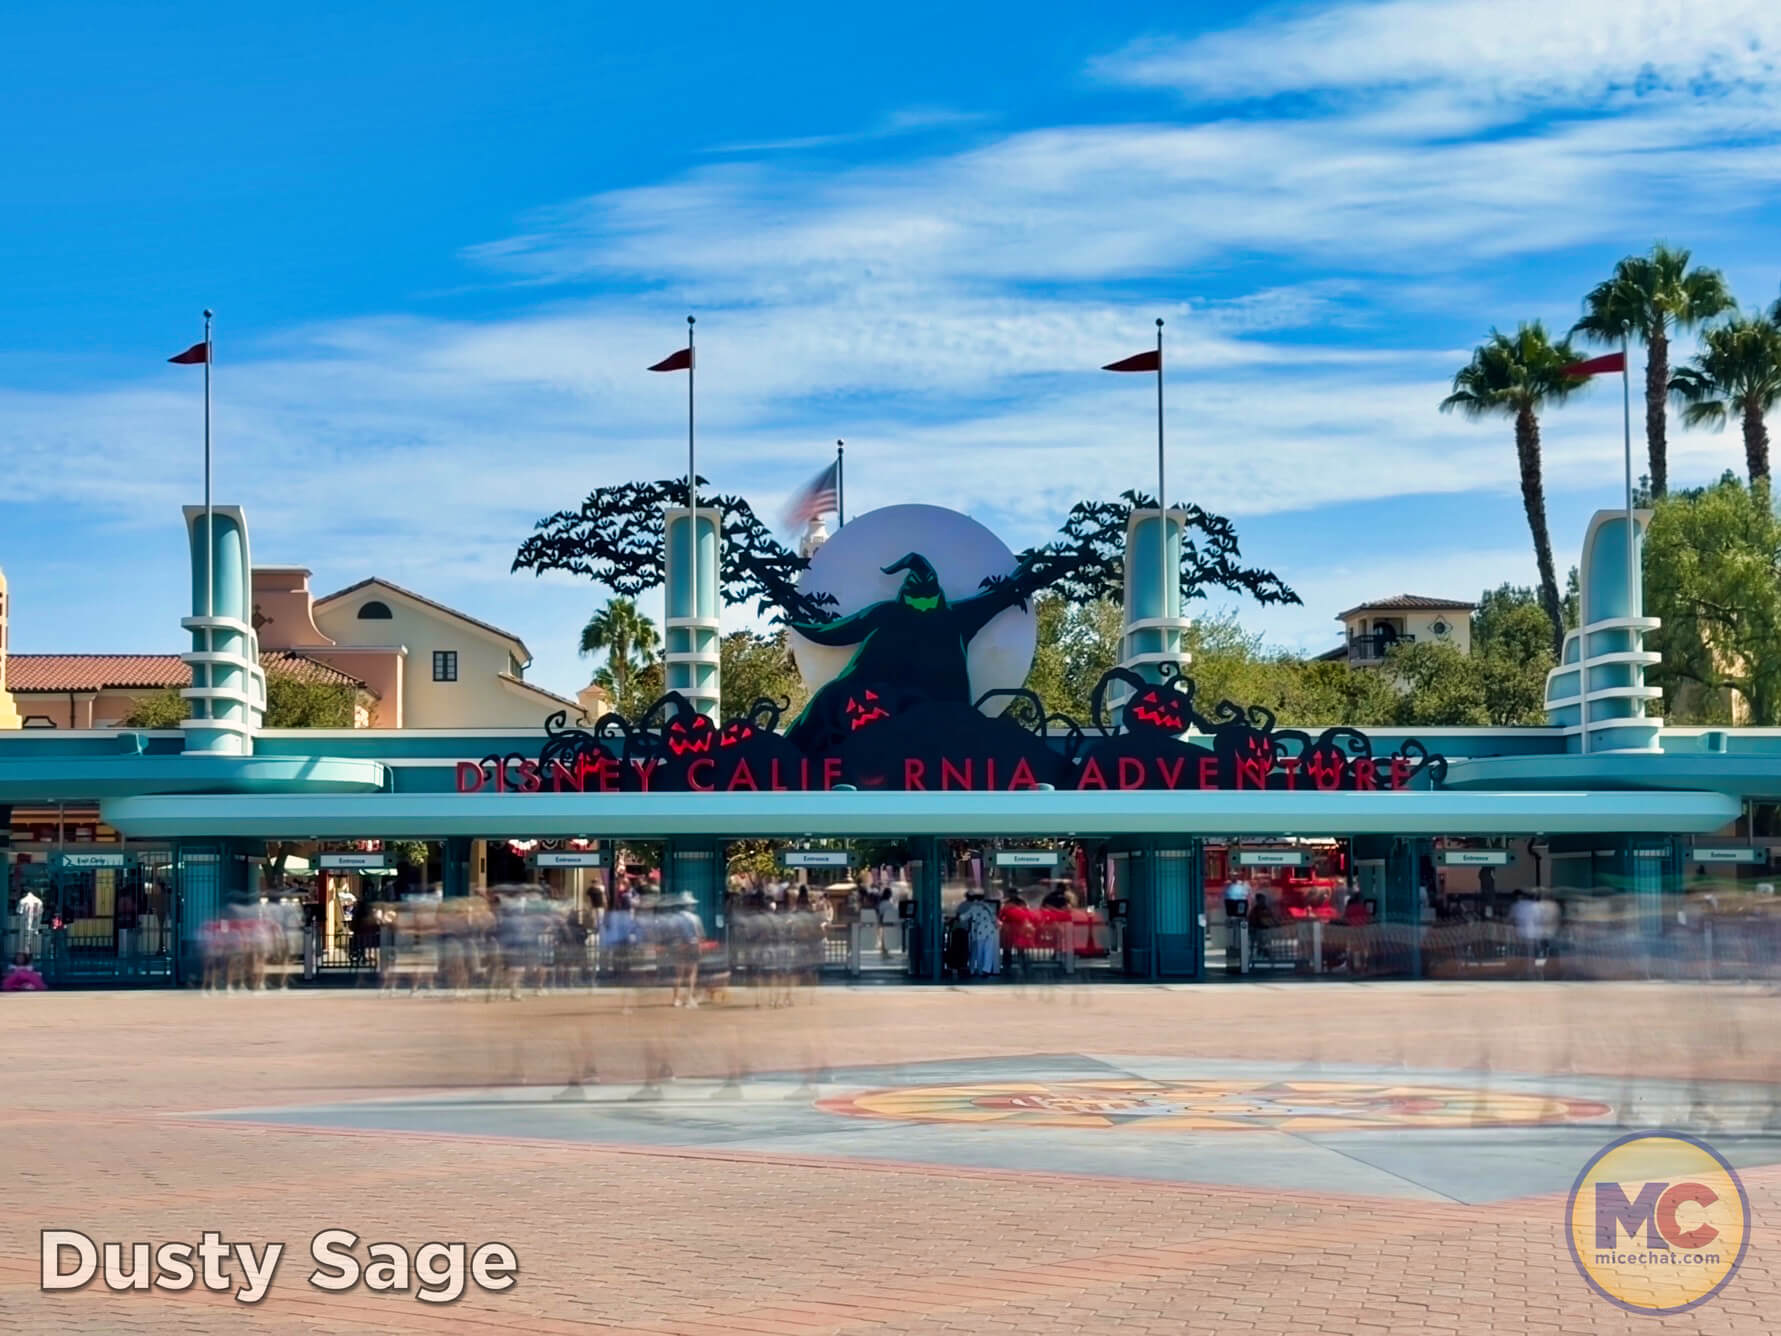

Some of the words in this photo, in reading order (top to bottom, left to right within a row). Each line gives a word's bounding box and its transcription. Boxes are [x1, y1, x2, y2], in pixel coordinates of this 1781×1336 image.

[456, 758, 658, 793] DISNEY
[686, 757, 1038, 792] CALIFRNIA
[1076, 756, 1412, 791] ADVENTURE
